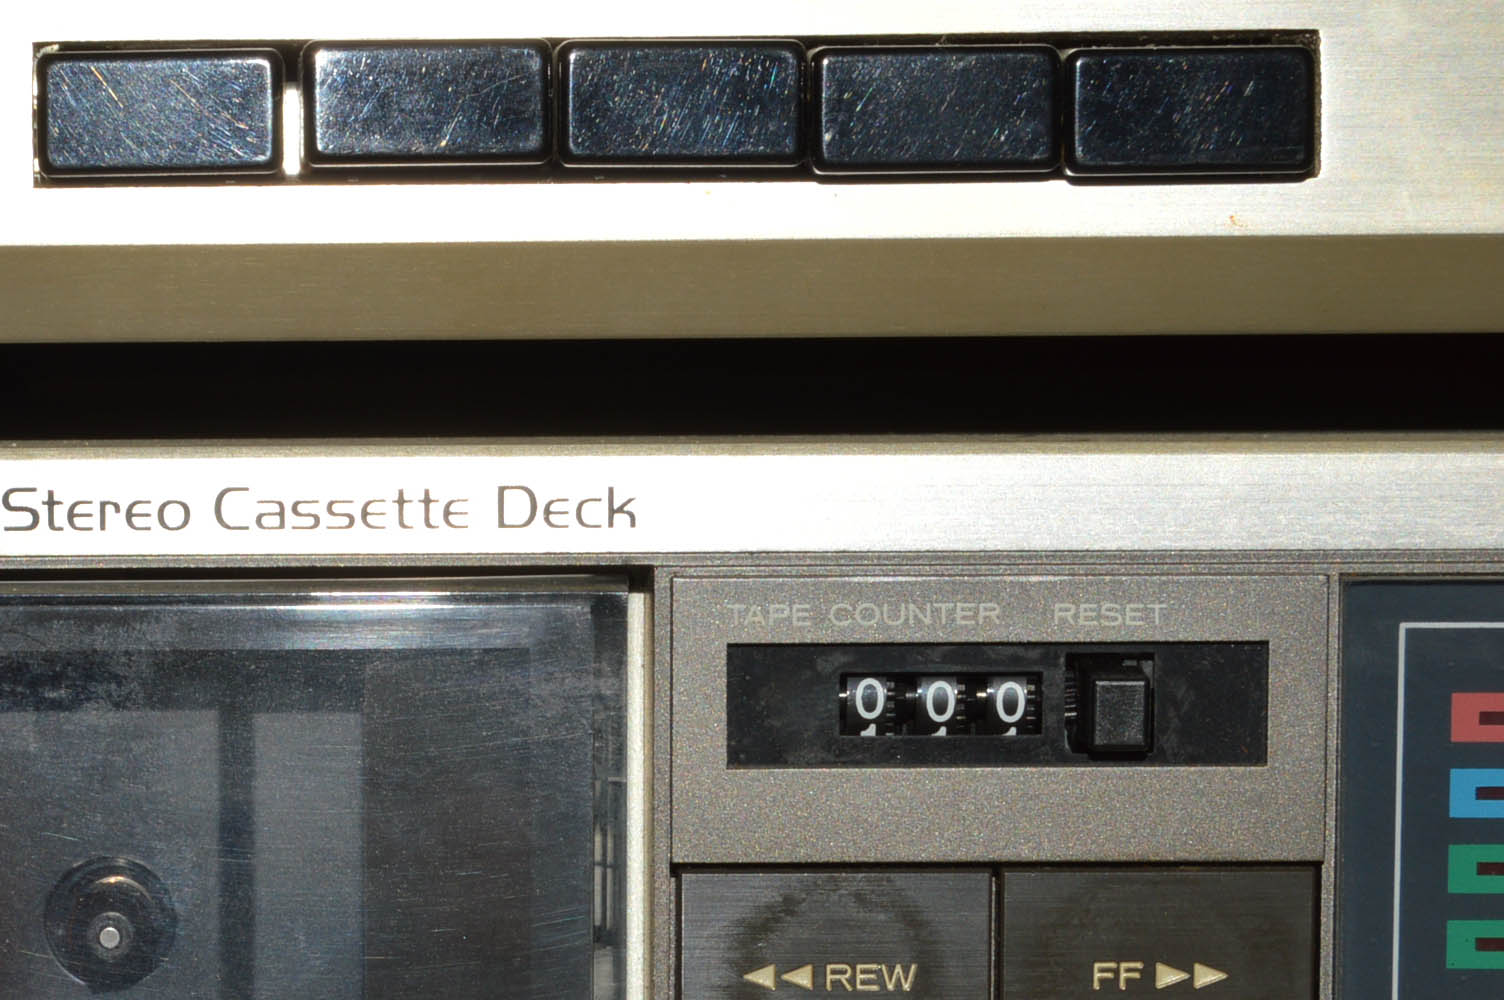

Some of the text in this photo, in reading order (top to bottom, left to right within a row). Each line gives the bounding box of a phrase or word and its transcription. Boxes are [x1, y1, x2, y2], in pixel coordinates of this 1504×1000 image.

[2, 486, 191, 532] Stereo
[214, 486, 469, 531] Cassette
[498, 485, 636, 529] Deck
[726, 603, 1000, 627] TAPE COUNTER
[1053, 603, 1167, 626] RESET
[826, 963, 918, 992] REW
[1093, 961, 1144, 990] FF
